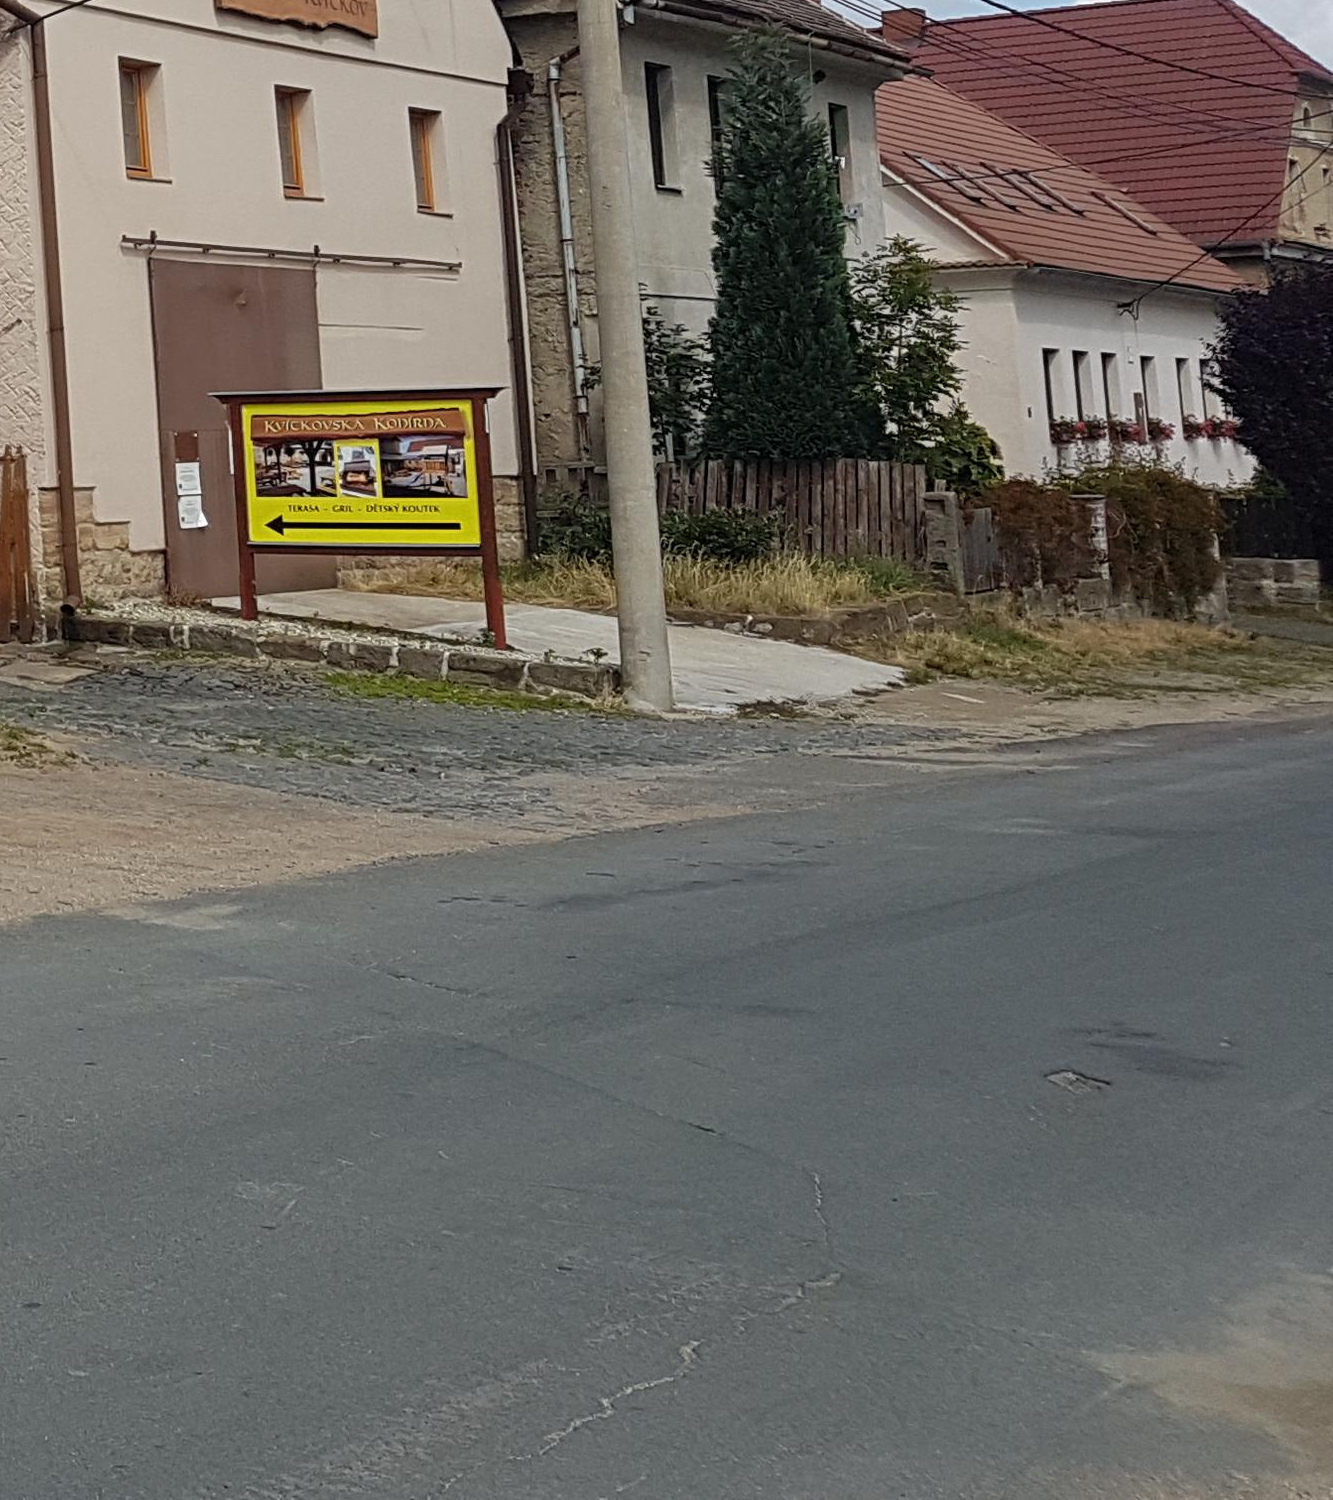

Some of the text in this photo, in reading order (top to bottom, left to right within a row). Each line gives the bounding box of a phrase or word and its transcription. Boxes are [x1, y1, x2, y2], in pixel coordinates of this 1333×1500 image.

[288, 504, 320, 513] TERASA
[333, 504, 353, 513] GRIL
[402, 504, 440, 513] KOUTEK
